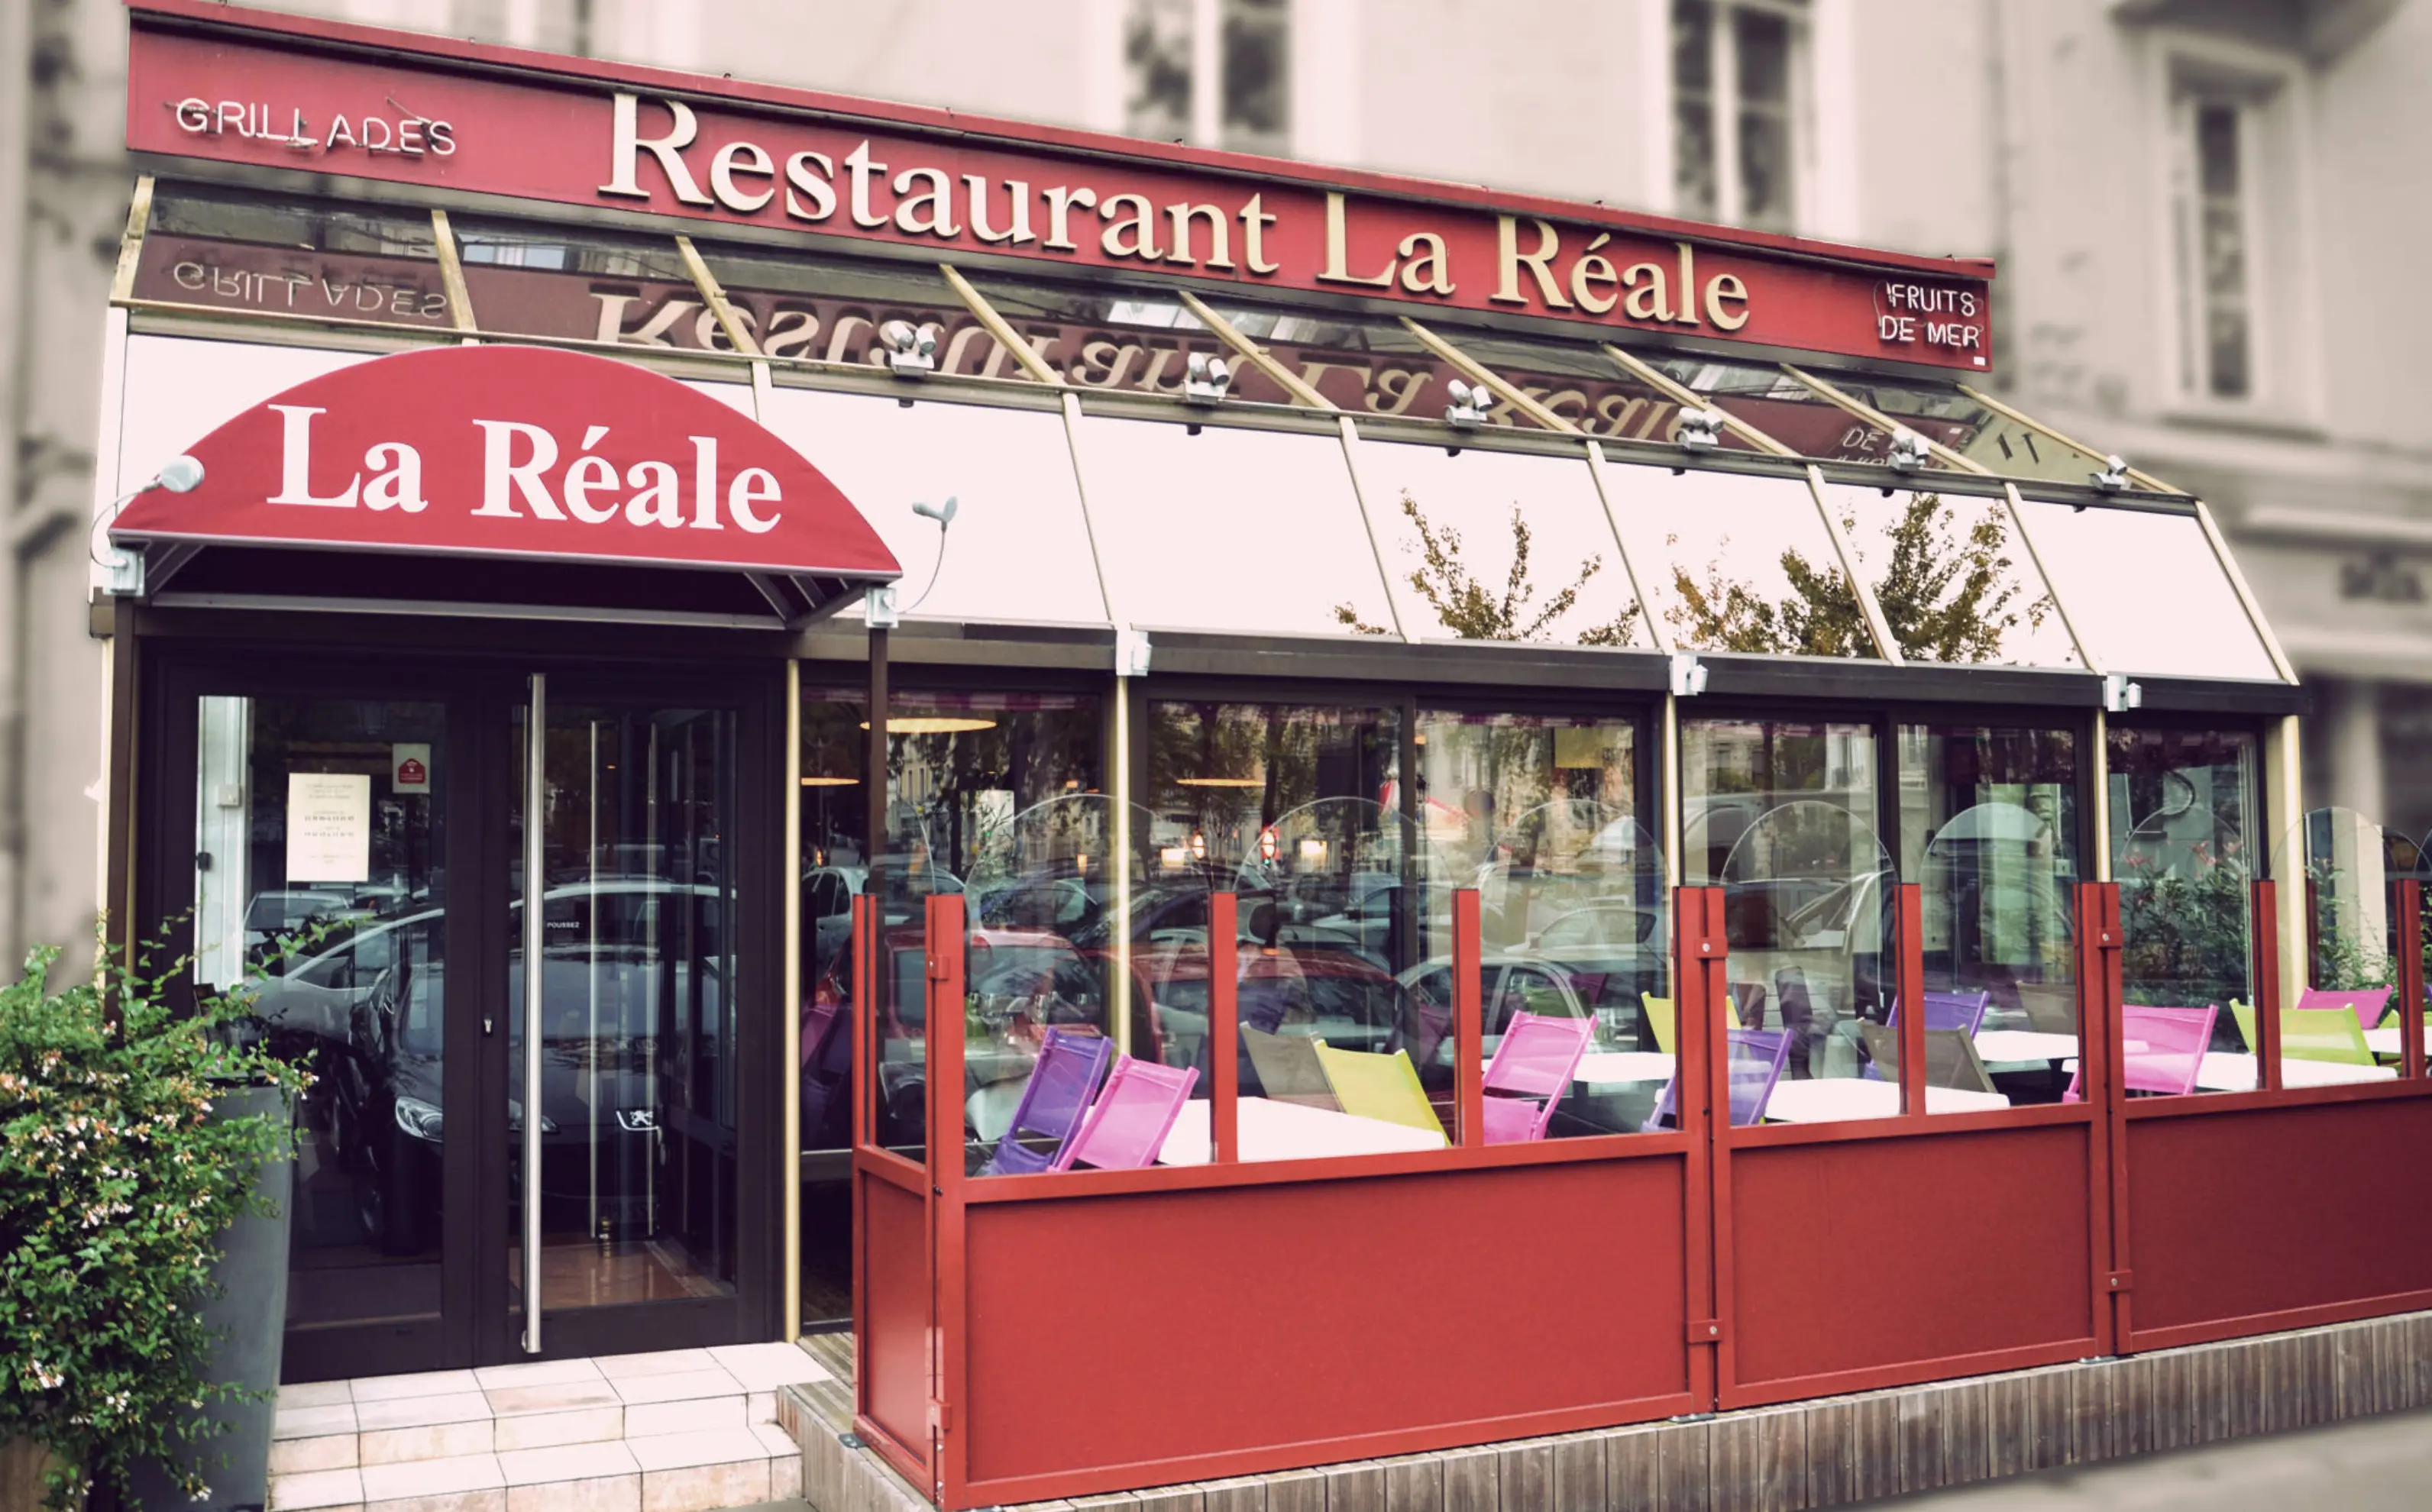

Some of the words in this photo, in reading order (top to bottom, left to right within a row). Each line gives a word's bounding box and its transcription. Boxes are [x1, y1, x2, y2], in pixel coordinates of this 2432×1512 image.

[175, 97, 457, 157] GRILLADES
[597, 92, 1280, 275] Restaurant
[1316, 191, 1457, 296] La
[1489, 215, 1751, 332] Réale
[1887, 283, 1976, 317] FRUITS
[1879, 315, 1916, 342] DE
[1926, 321, 1981, 350] MER
[266, 403, 429, 513] La
[470, 418, 783, 534] Réale
